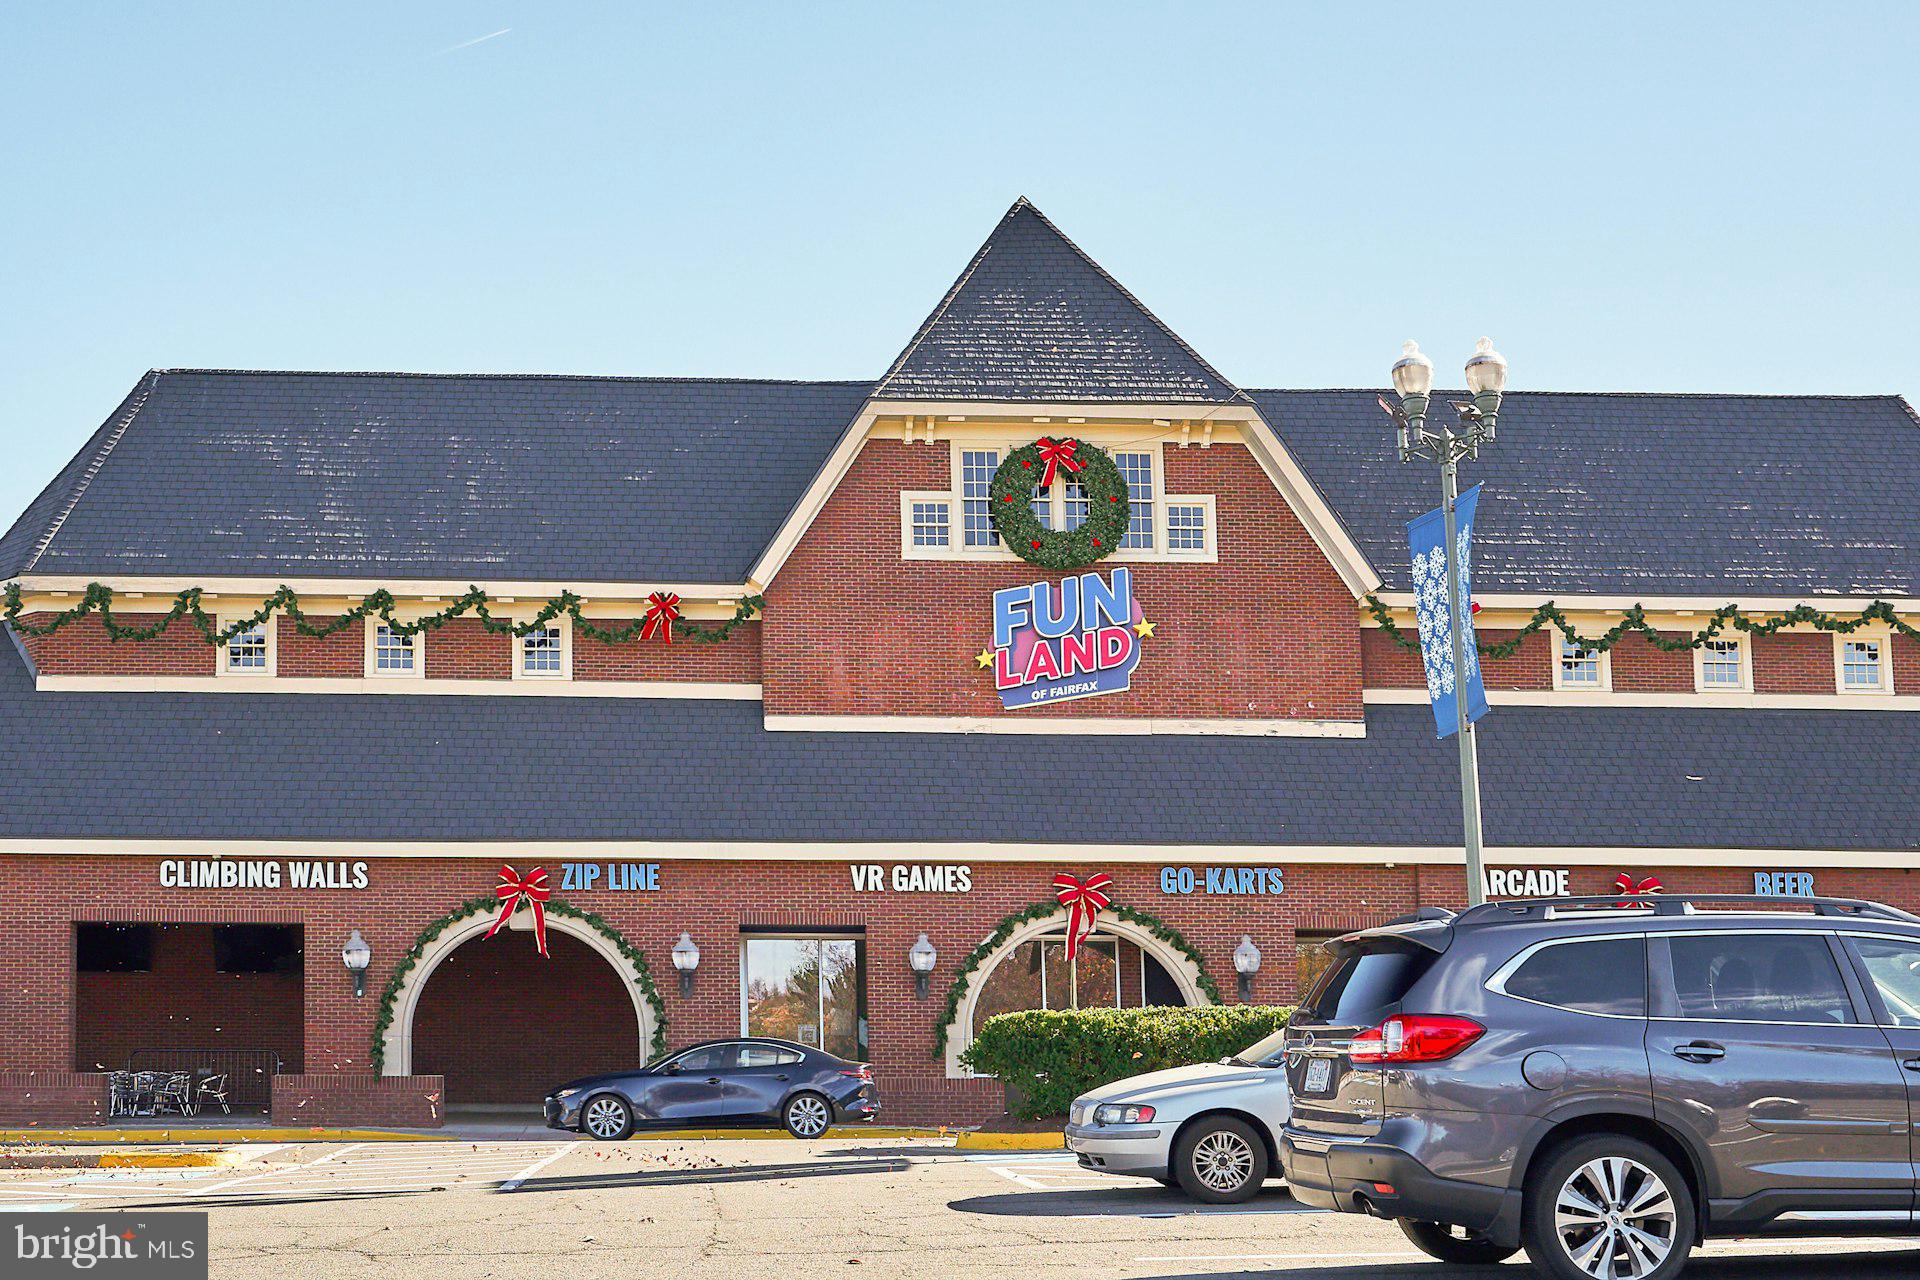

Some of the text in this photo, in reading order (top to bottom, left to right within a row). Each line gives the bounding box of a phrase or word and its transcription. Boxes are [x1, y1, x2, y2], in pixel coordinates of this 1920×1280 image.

[993, 567, 1131, 647] FUN
[995, 626, 1133, 689] LAND
[1031, 681, 1098, 700] OF FAIRFAX
[159, 860, 369, 889] CLIMBING WALLS
[561, 863, 661, 890] ZIP LINE
[850, 864, 972, 892] VR GAMES
[1160, 866, 1284, 895] GO-KARTS
[1754, 872, 1815, 897] BEER
[1347, 1098, 1376, 1106] ASCENT
